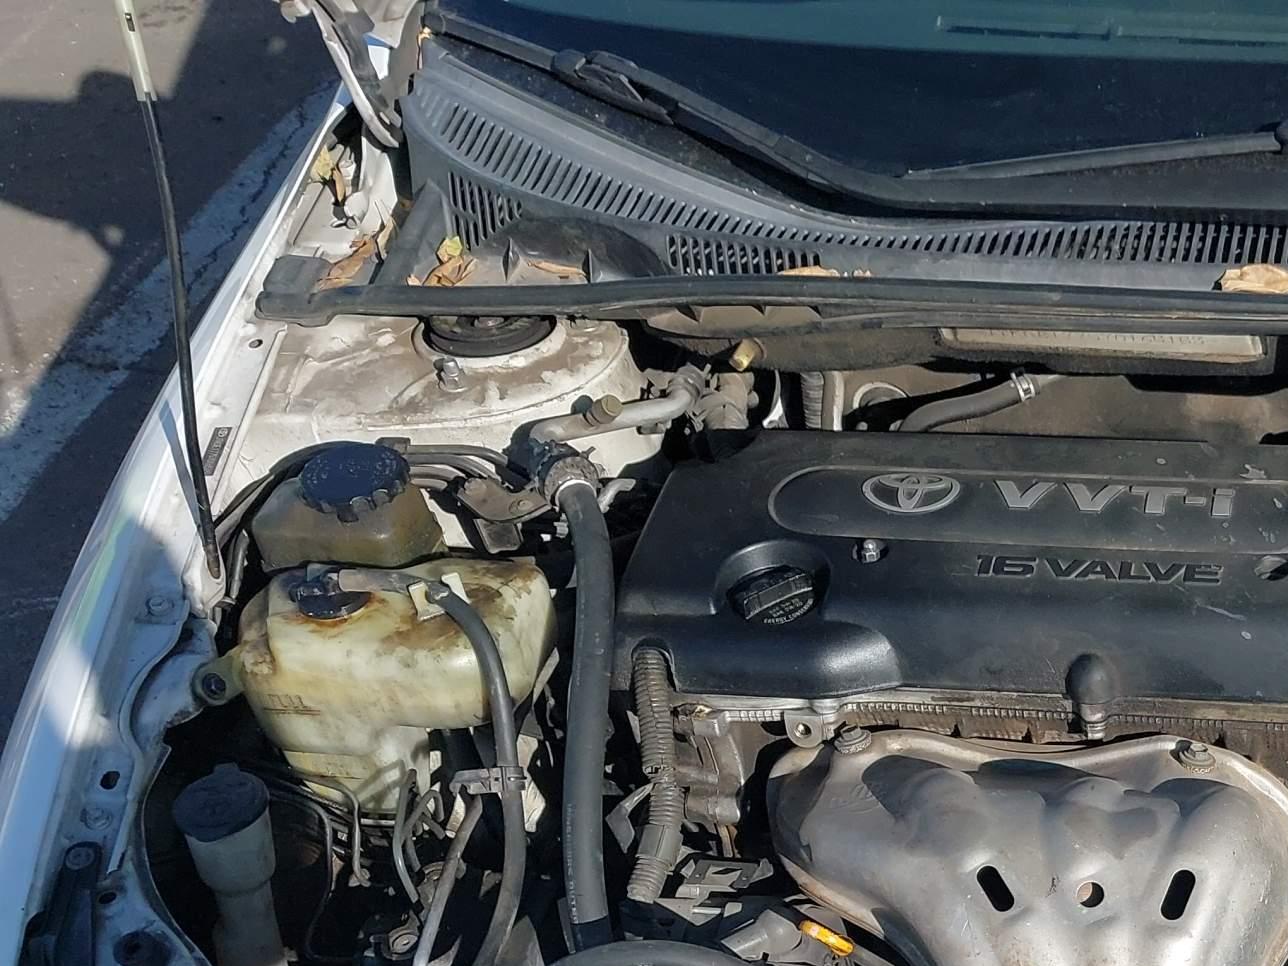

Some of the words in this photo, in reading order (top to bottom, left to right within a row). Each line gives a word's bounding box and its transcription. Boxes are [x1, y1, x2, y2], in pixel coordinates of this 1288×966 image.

[993, 480, 1236, 517] VVT-i
[977, 555, 1037, 578] 16
[1046, 559, 1223, 584] VALVE
